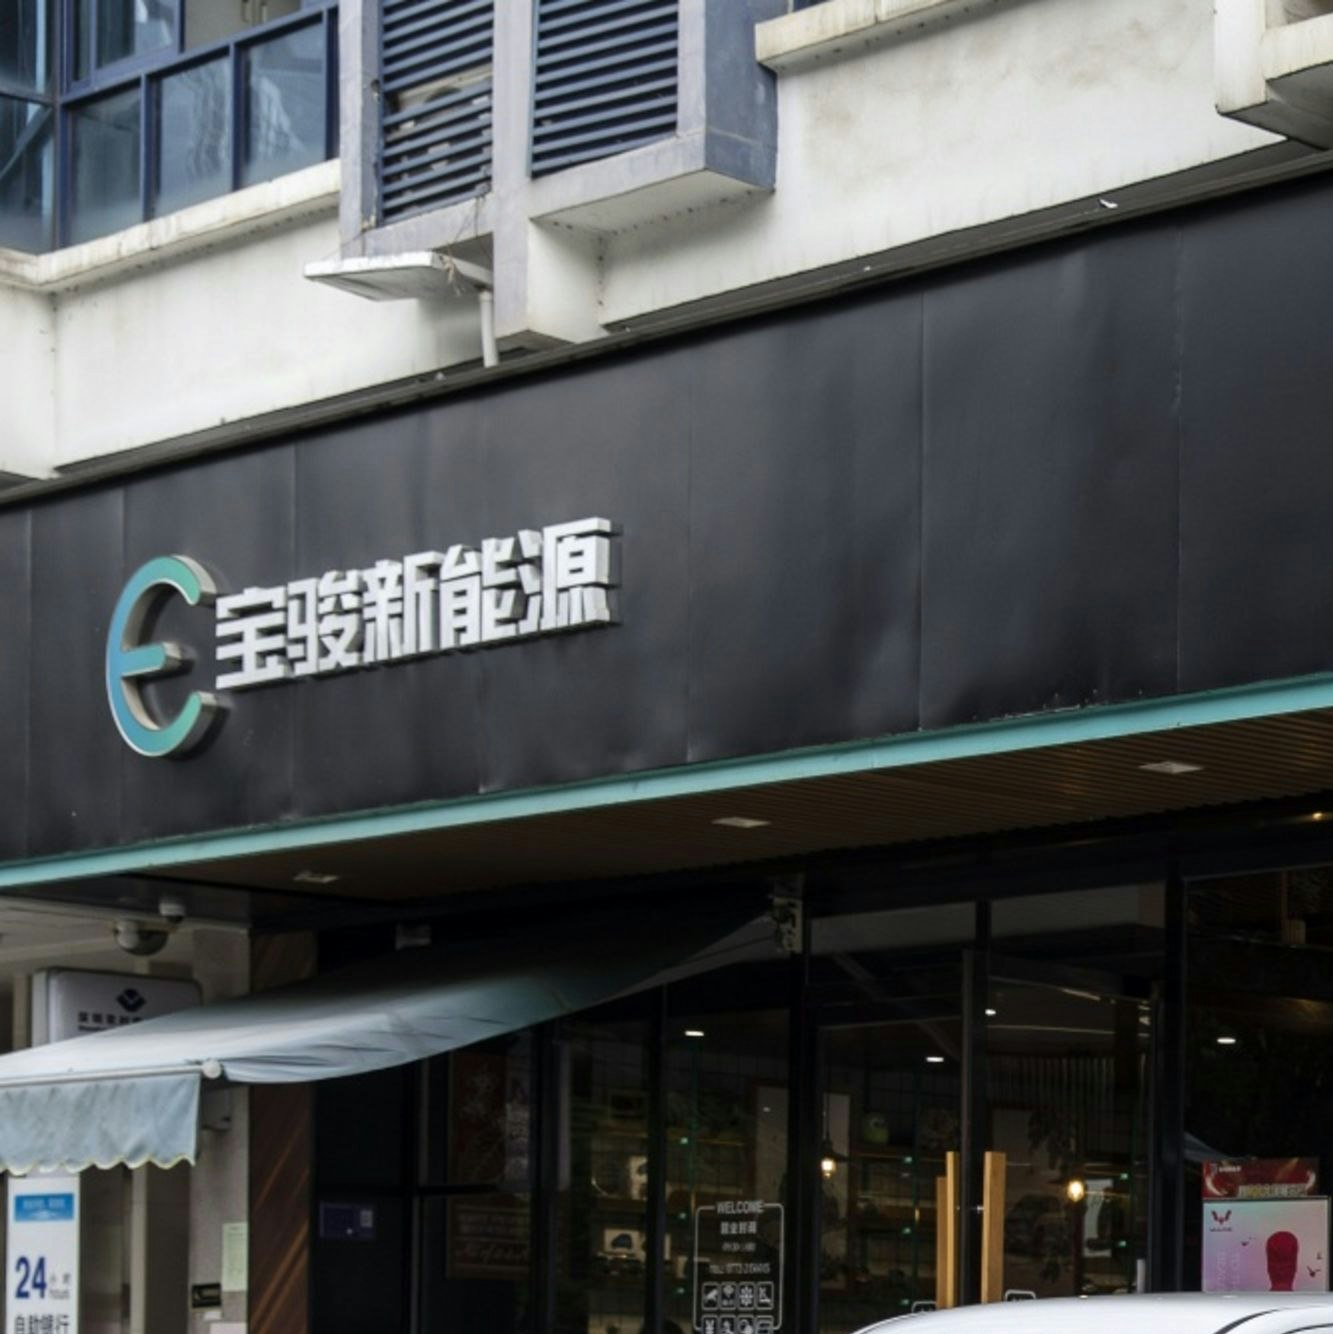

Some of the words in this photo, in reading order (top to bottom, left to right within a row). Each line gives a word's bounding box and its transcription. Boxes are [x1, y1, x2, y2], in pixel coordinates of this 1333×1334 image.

[214, 517, 619, 691] 宝骏新能源
[716, 1200, 764, 1214] WELCOME
[15, 1256, 47, 1299] 24
